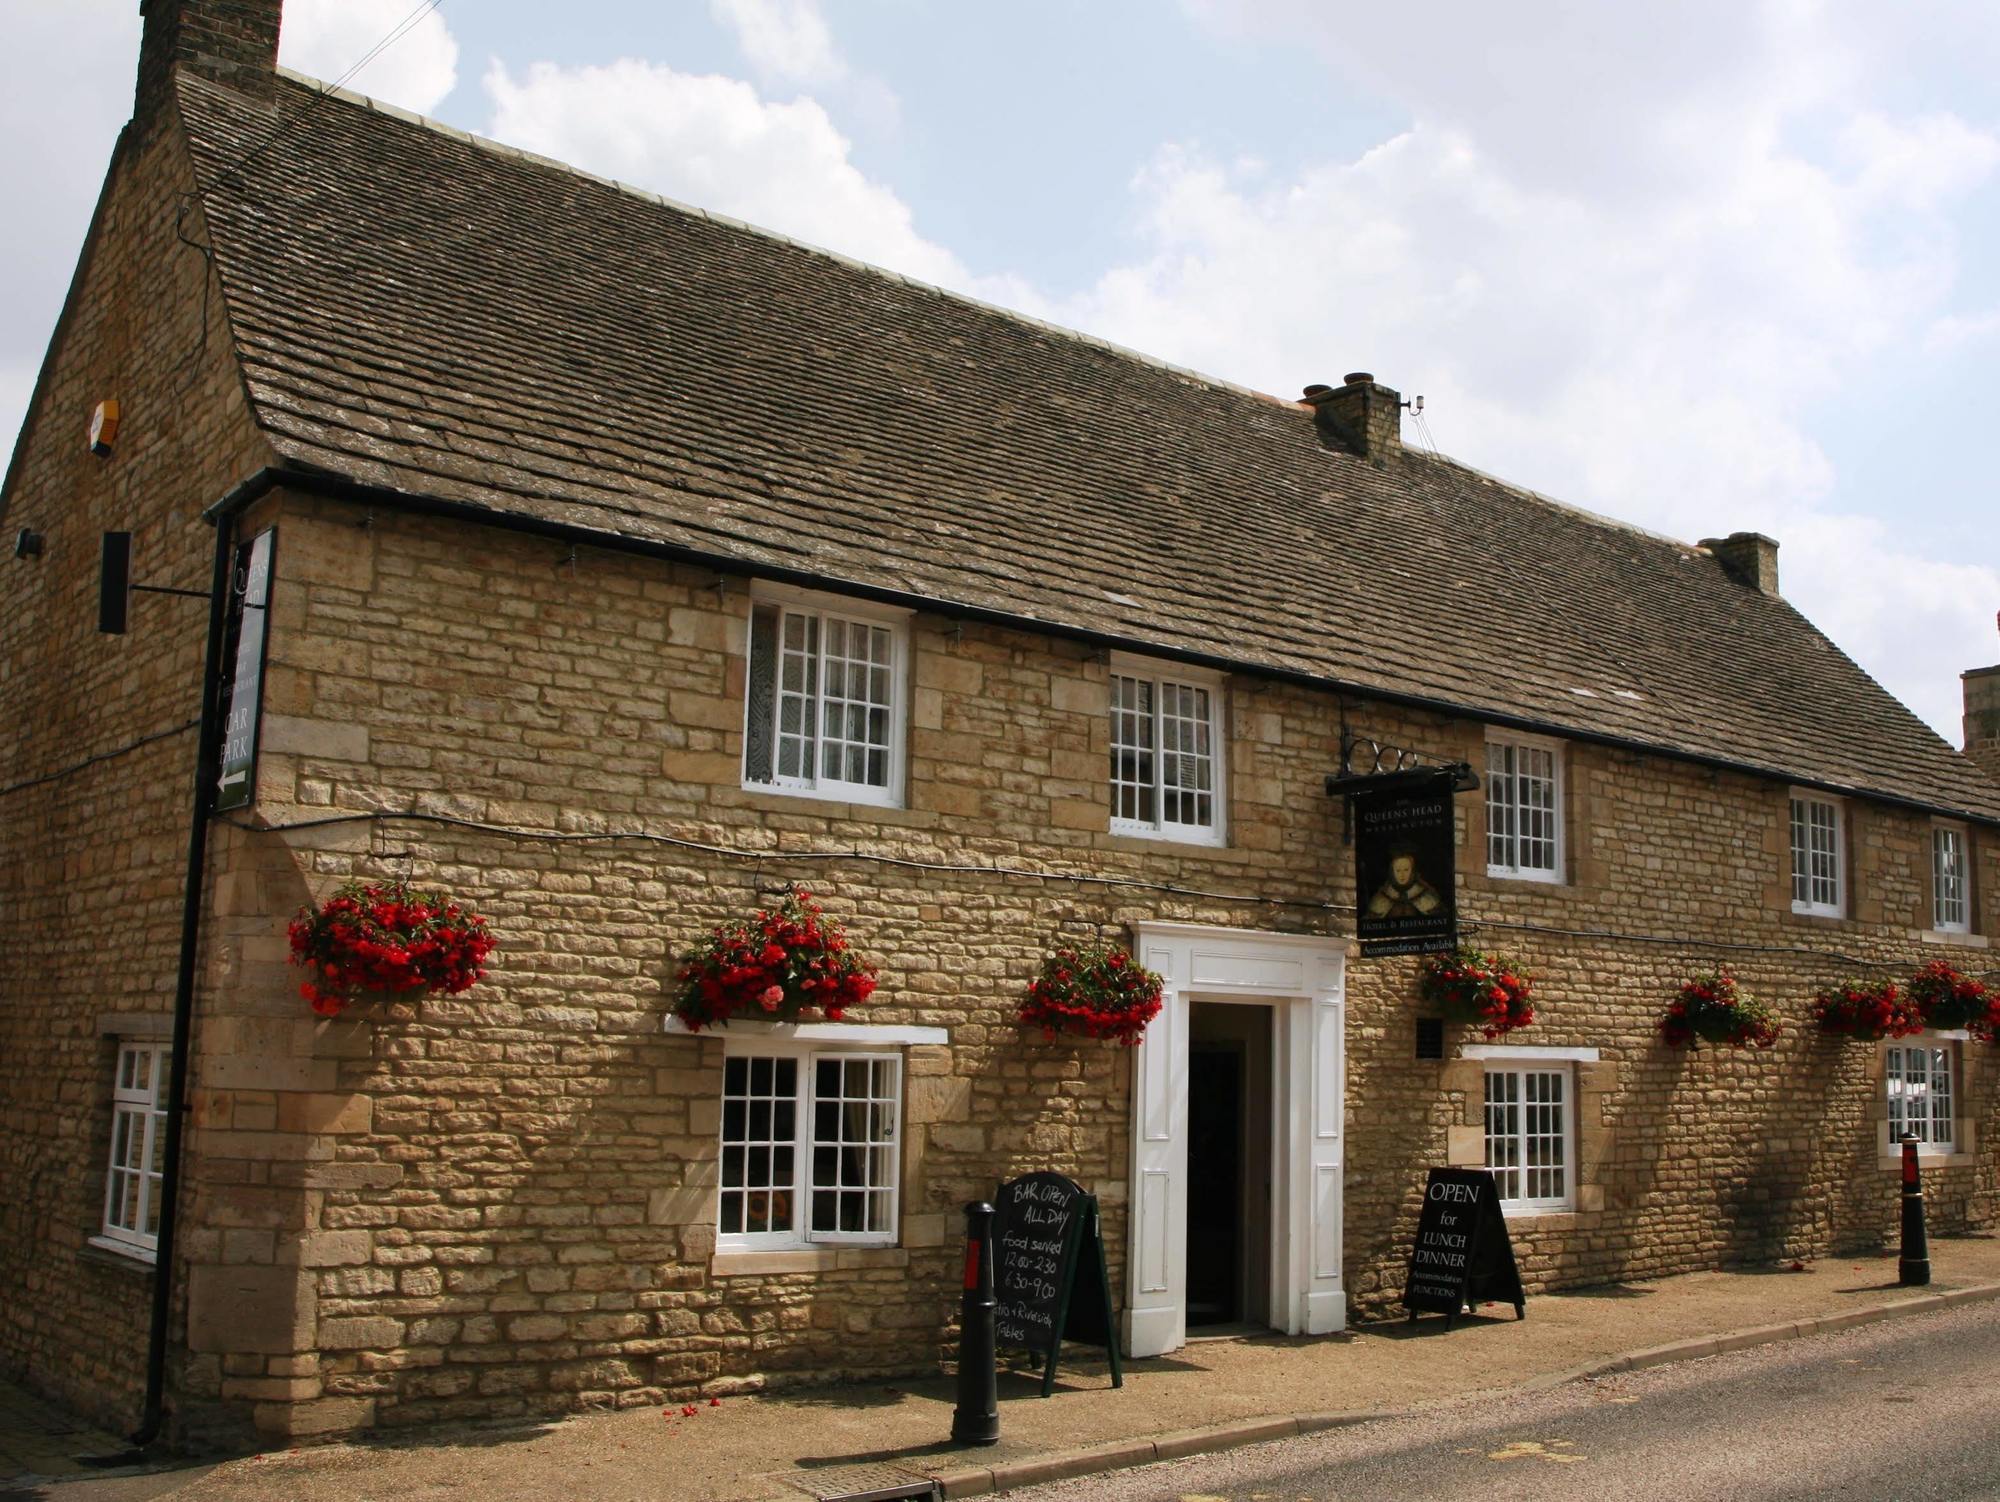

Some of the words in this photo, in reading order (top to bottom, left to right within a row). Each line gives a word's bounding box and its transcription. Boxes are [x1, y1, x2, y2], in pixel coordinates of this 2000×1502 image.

[224, 707, 248, 735] CAR
[219, 735, 248, 766] PARK
[1364, 808, 1408, 823] QUEENS
[1412, 804, 1442, 817] HEAD
[1364, 942, 1420, 955] Accommodation
[1422, 938, 1456, 952] Available
[1013, 1181, 1038, 1203] BAR
[1040, 1184, 1072, 1208] OPEN
[1429, 1182, 1480, 1204] OPEN
[1024, 1205, 1046, 1224] ALL
[1047, 1208, 1070, 1236] DAY
[1440, 1210, 1459, 1227] for
[1030, 1238, 1064, 1256] served
[1423, 1231, 1467, 1249] LUNCH
[1416, 1249, 1466, 1268] DINNER
[1412, 1284, 1456, 1298] FUNCTIONS
[995, 1320, 1025, 1342] Tables
